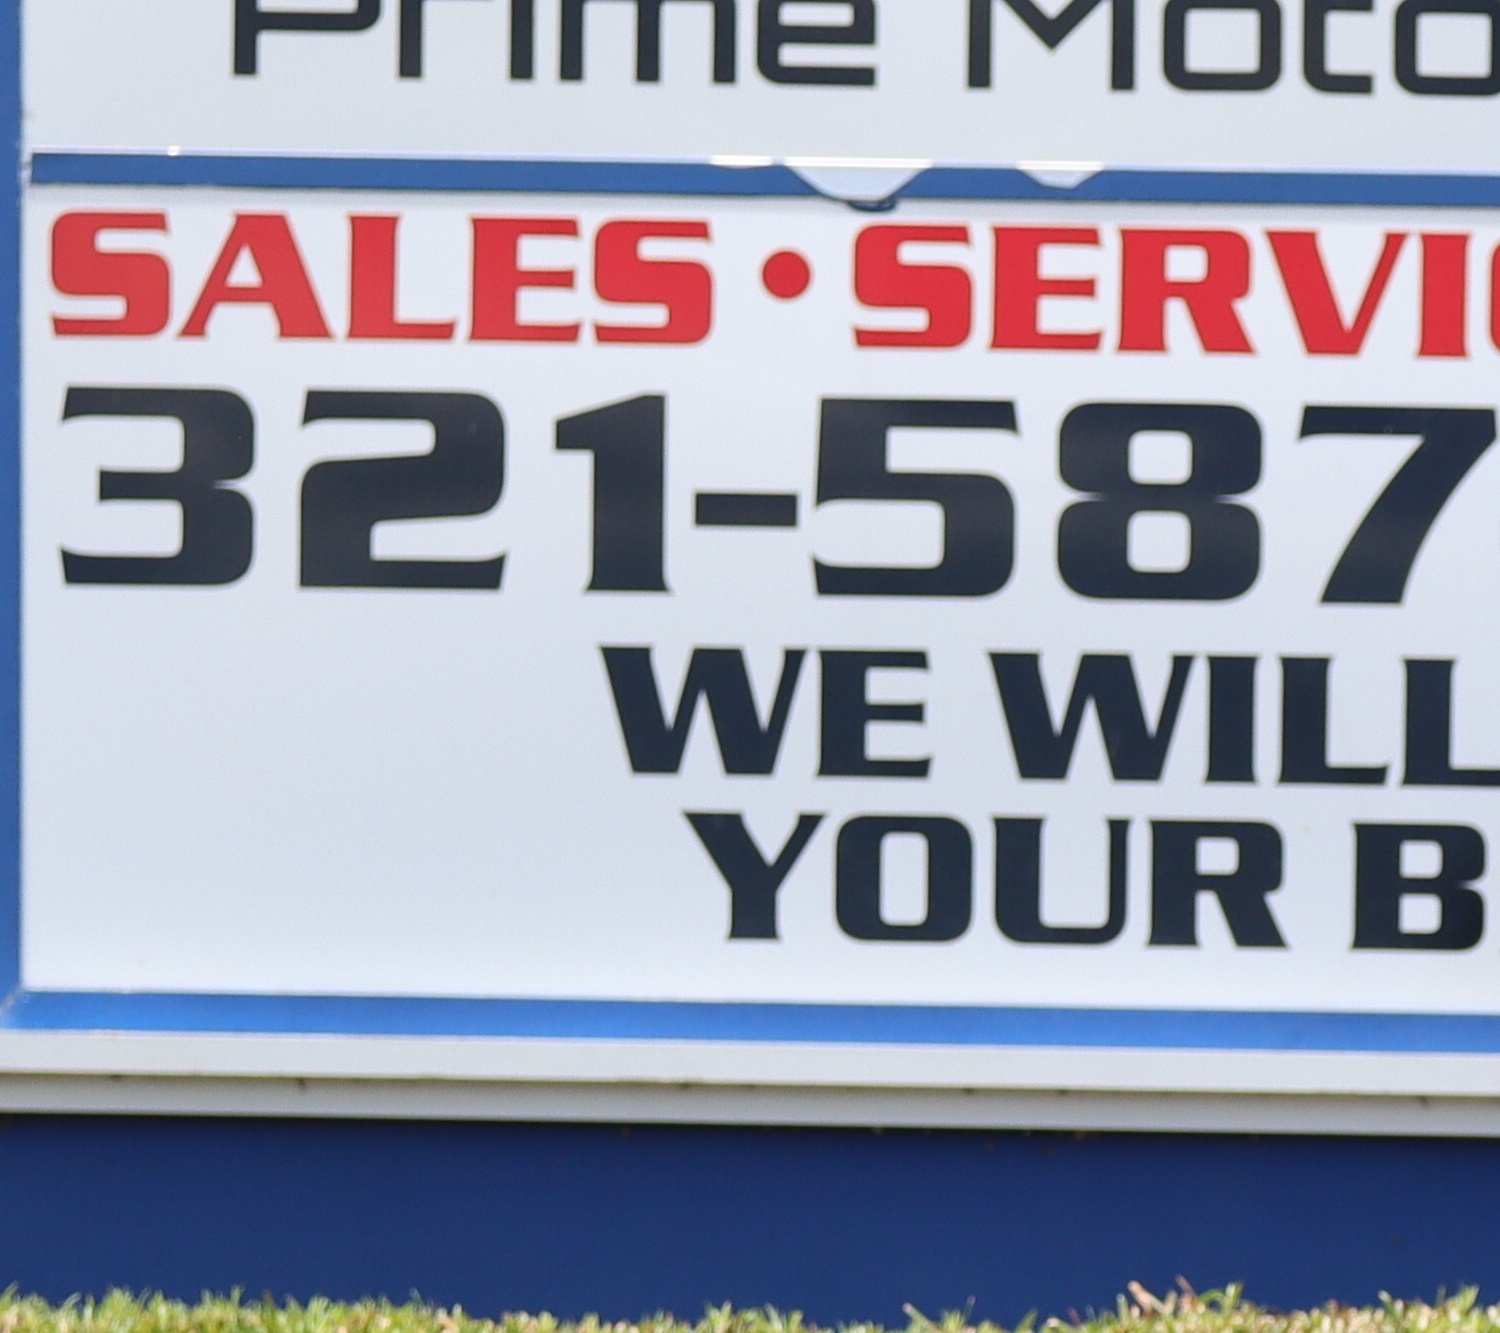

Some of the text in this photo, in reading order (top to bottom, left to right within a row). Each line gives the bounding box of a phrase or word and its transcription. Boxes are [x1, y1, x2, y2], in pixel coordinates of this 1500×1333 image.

[232, 0, 877, 87] Prime
[49, 211, 714, 346] SALES
[600, 646, 931, 779] WE
[684, 812, 1286, 948] YOUR
